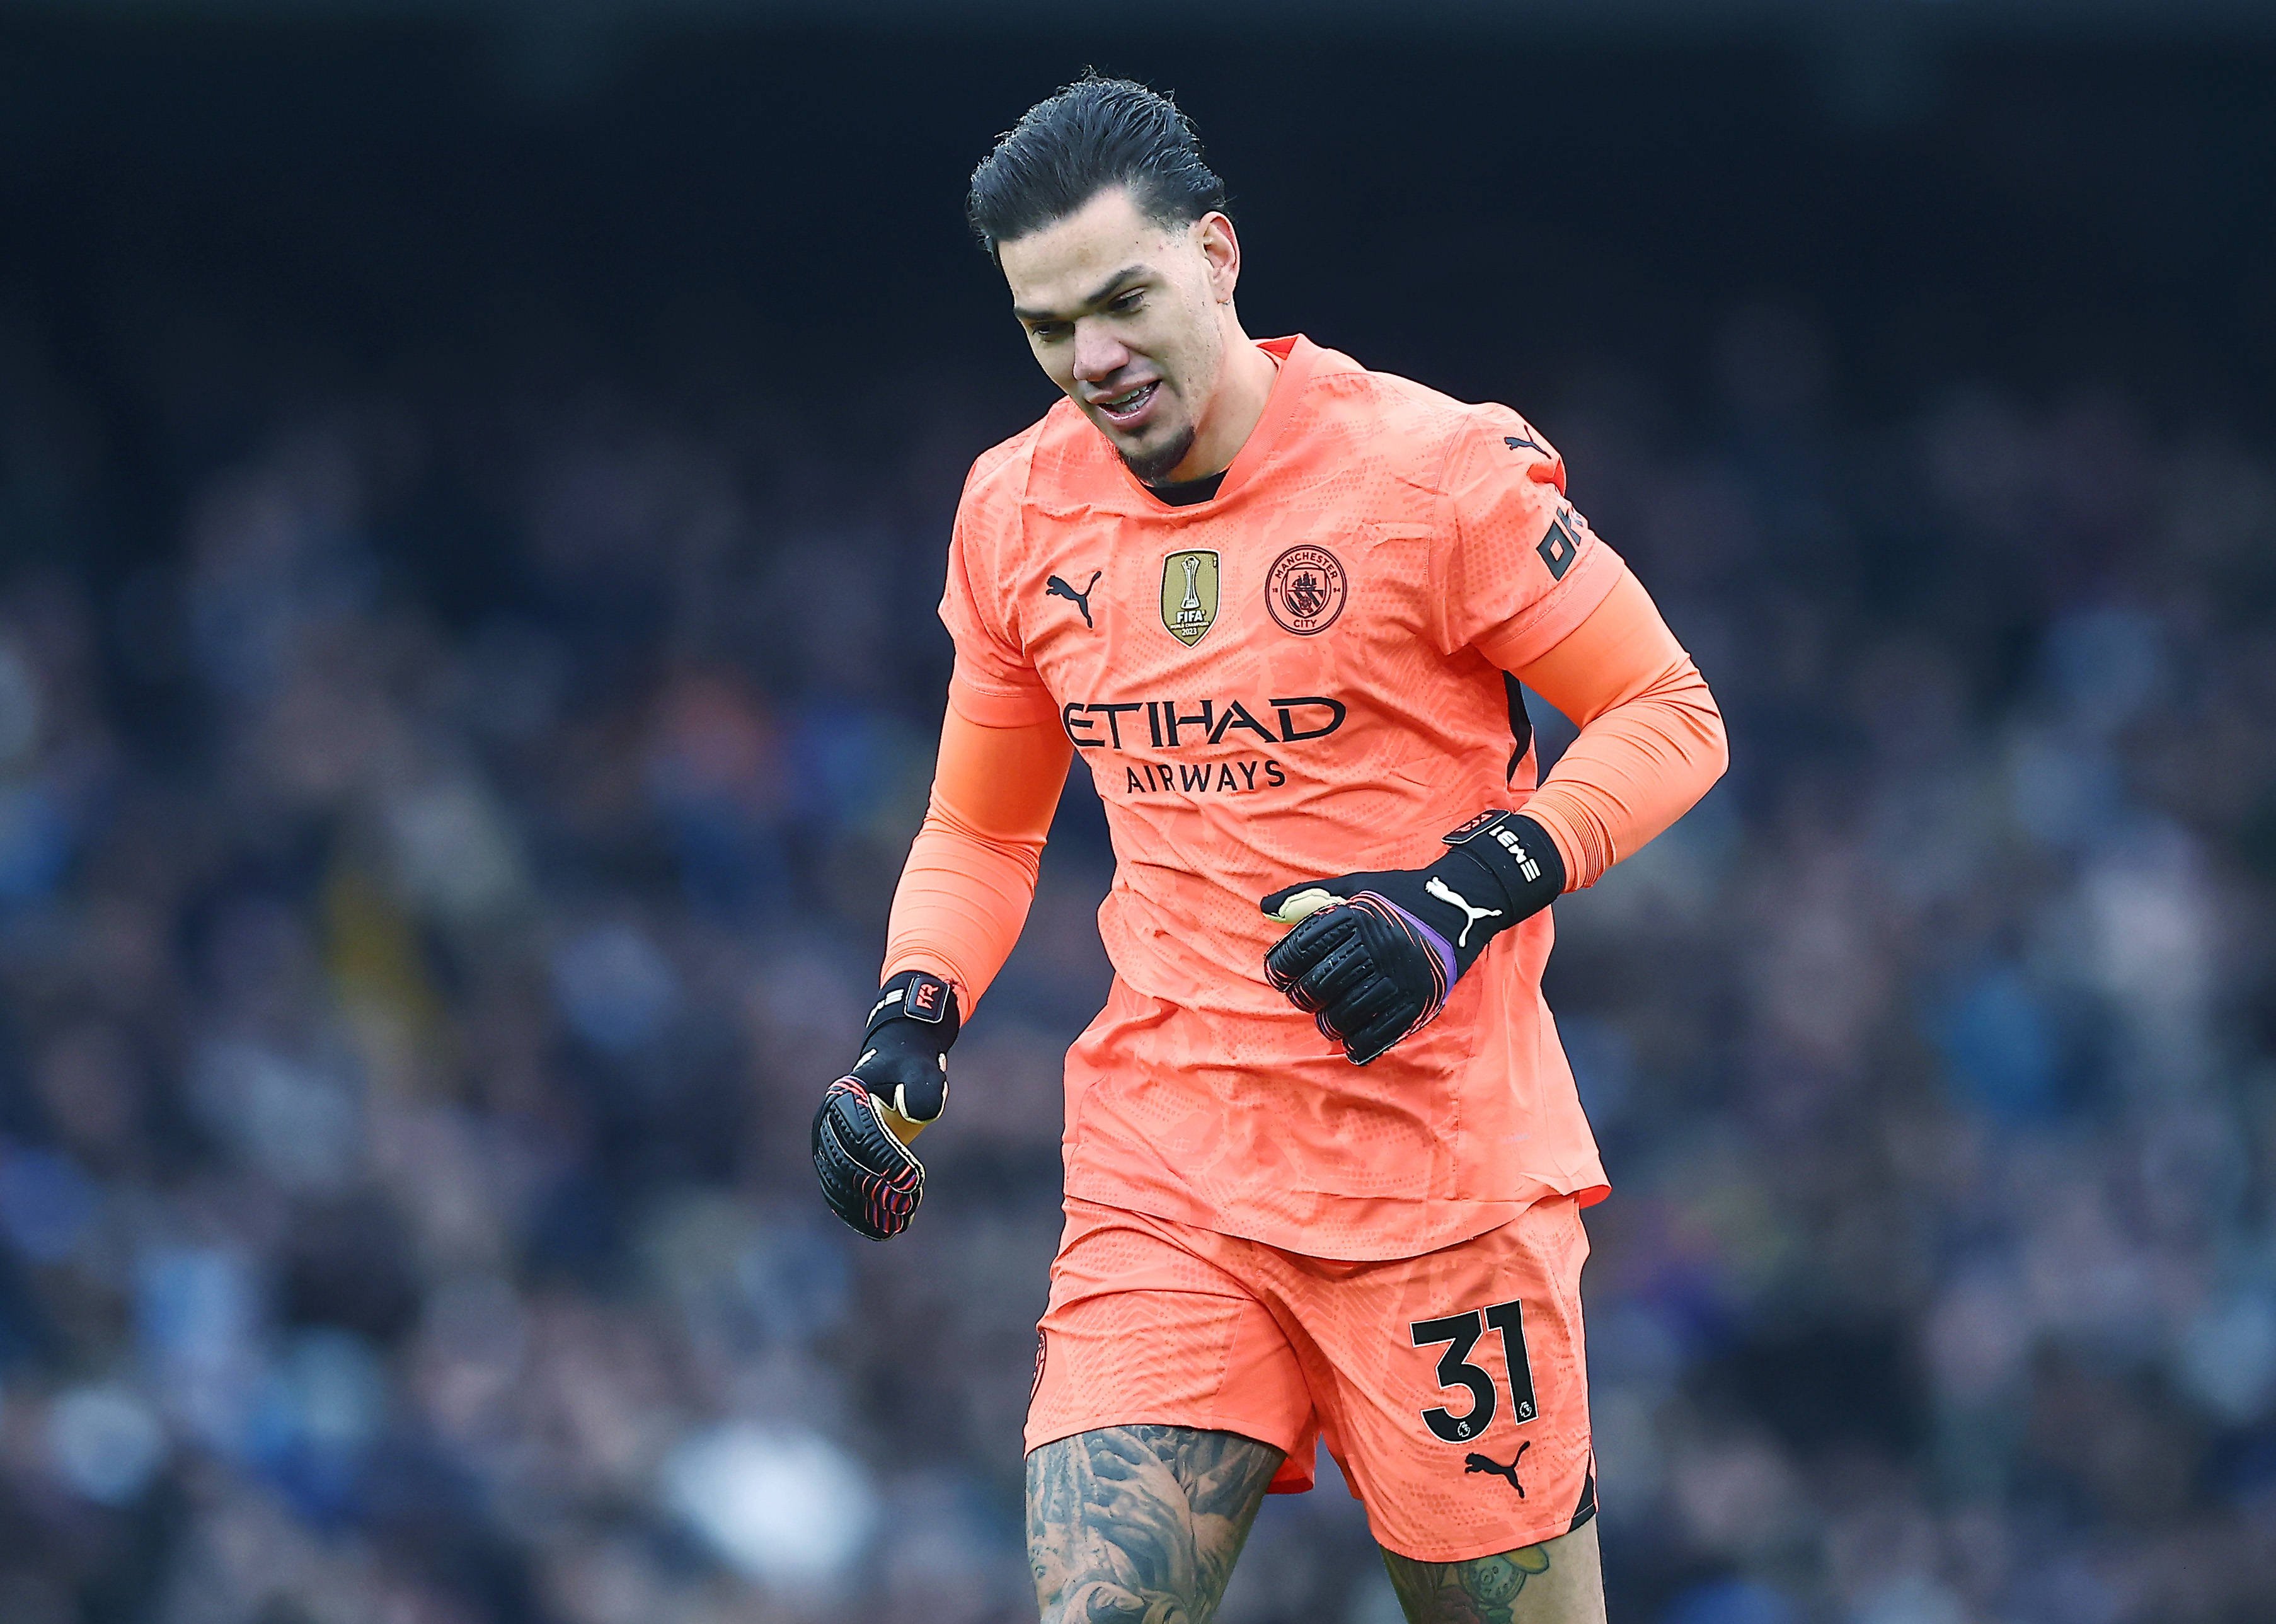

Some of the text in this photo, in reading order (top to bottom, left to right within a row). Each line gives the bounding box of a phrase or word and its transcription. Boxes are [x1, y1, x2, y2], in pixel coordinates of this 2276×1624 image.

[1275, 551, 1338, 579] MANCHESTER
[1176, 610, 1204, 623] FIFA
[1293, 619, 1318, 628] CITY
[1181, 627, 1198, 636] 2023
[1062, 696, 1347, 750] ETIHAD
[1127, 759, 1286, 794] AIRWAYS
[1410, 1298, 1539, 1444] 31
